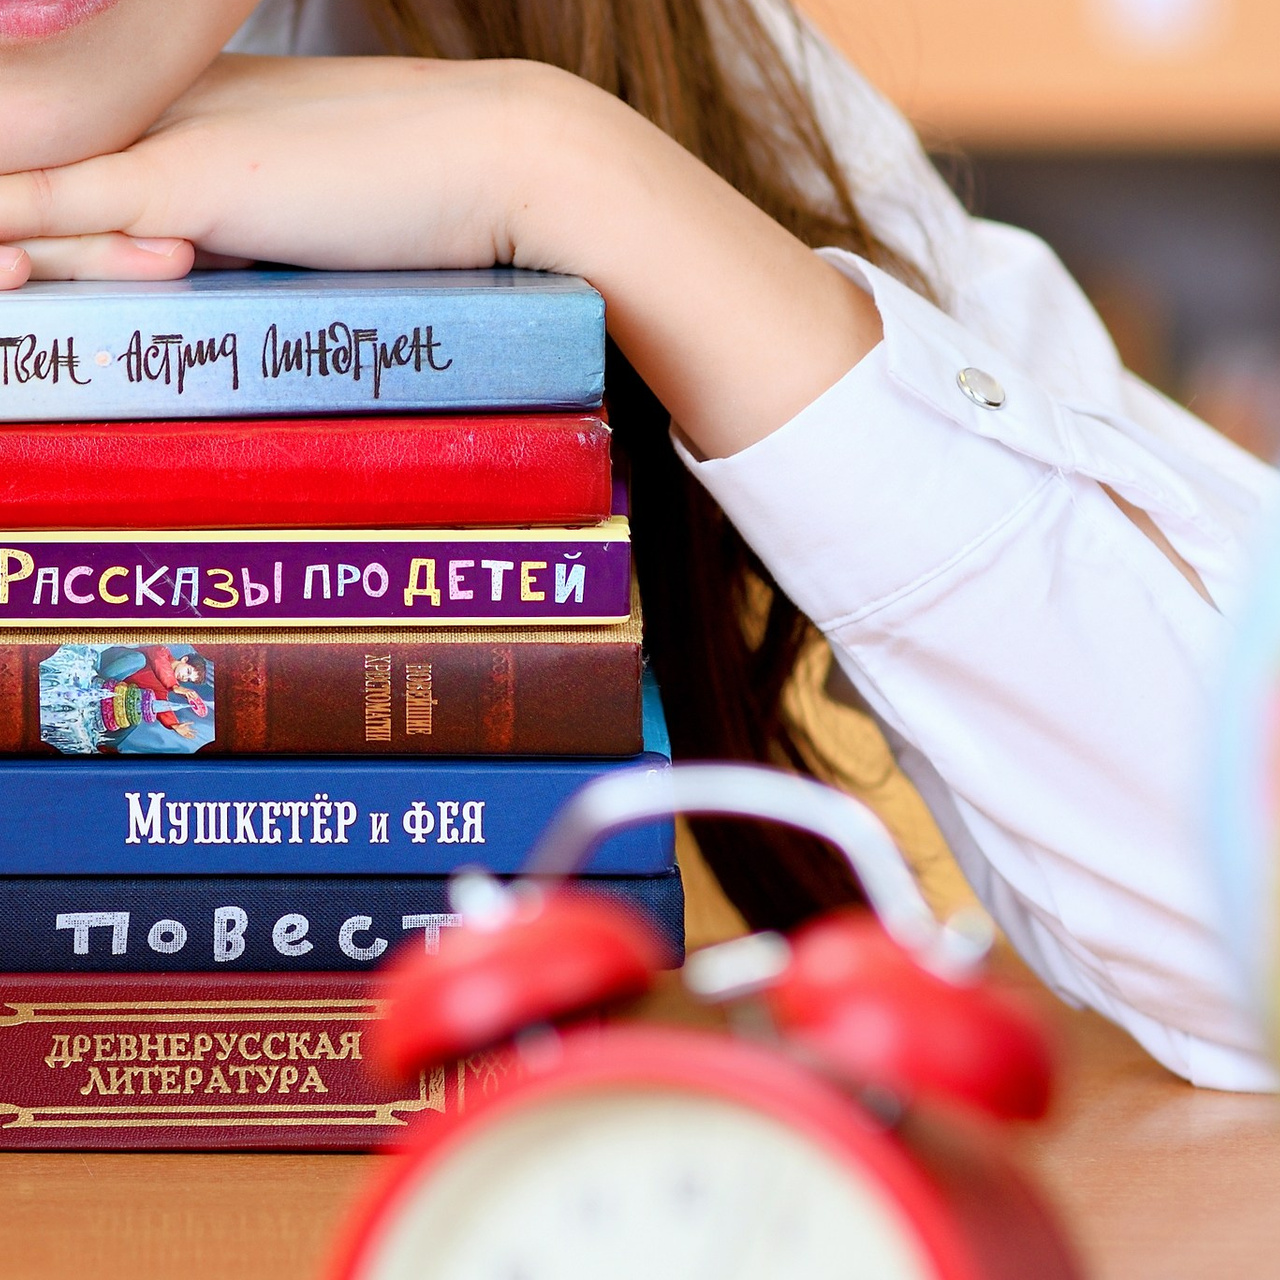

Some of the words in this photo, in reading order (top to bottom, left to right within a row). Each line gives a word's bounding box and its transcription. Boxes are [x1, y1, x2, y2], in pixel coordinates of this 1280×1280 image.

[364, 654, 392, 742] ХРЕСТОМАТИИ
[405, 662, 439, 735] НОВЕЙШИЕ
[403, 800, 486, 845] ФЕЯ
[45, 1031, 363, 1069] ДРЕВНЕРУССКАЯ
[80, 1065, 329, 1095] ЛИТЕРАТУРА
